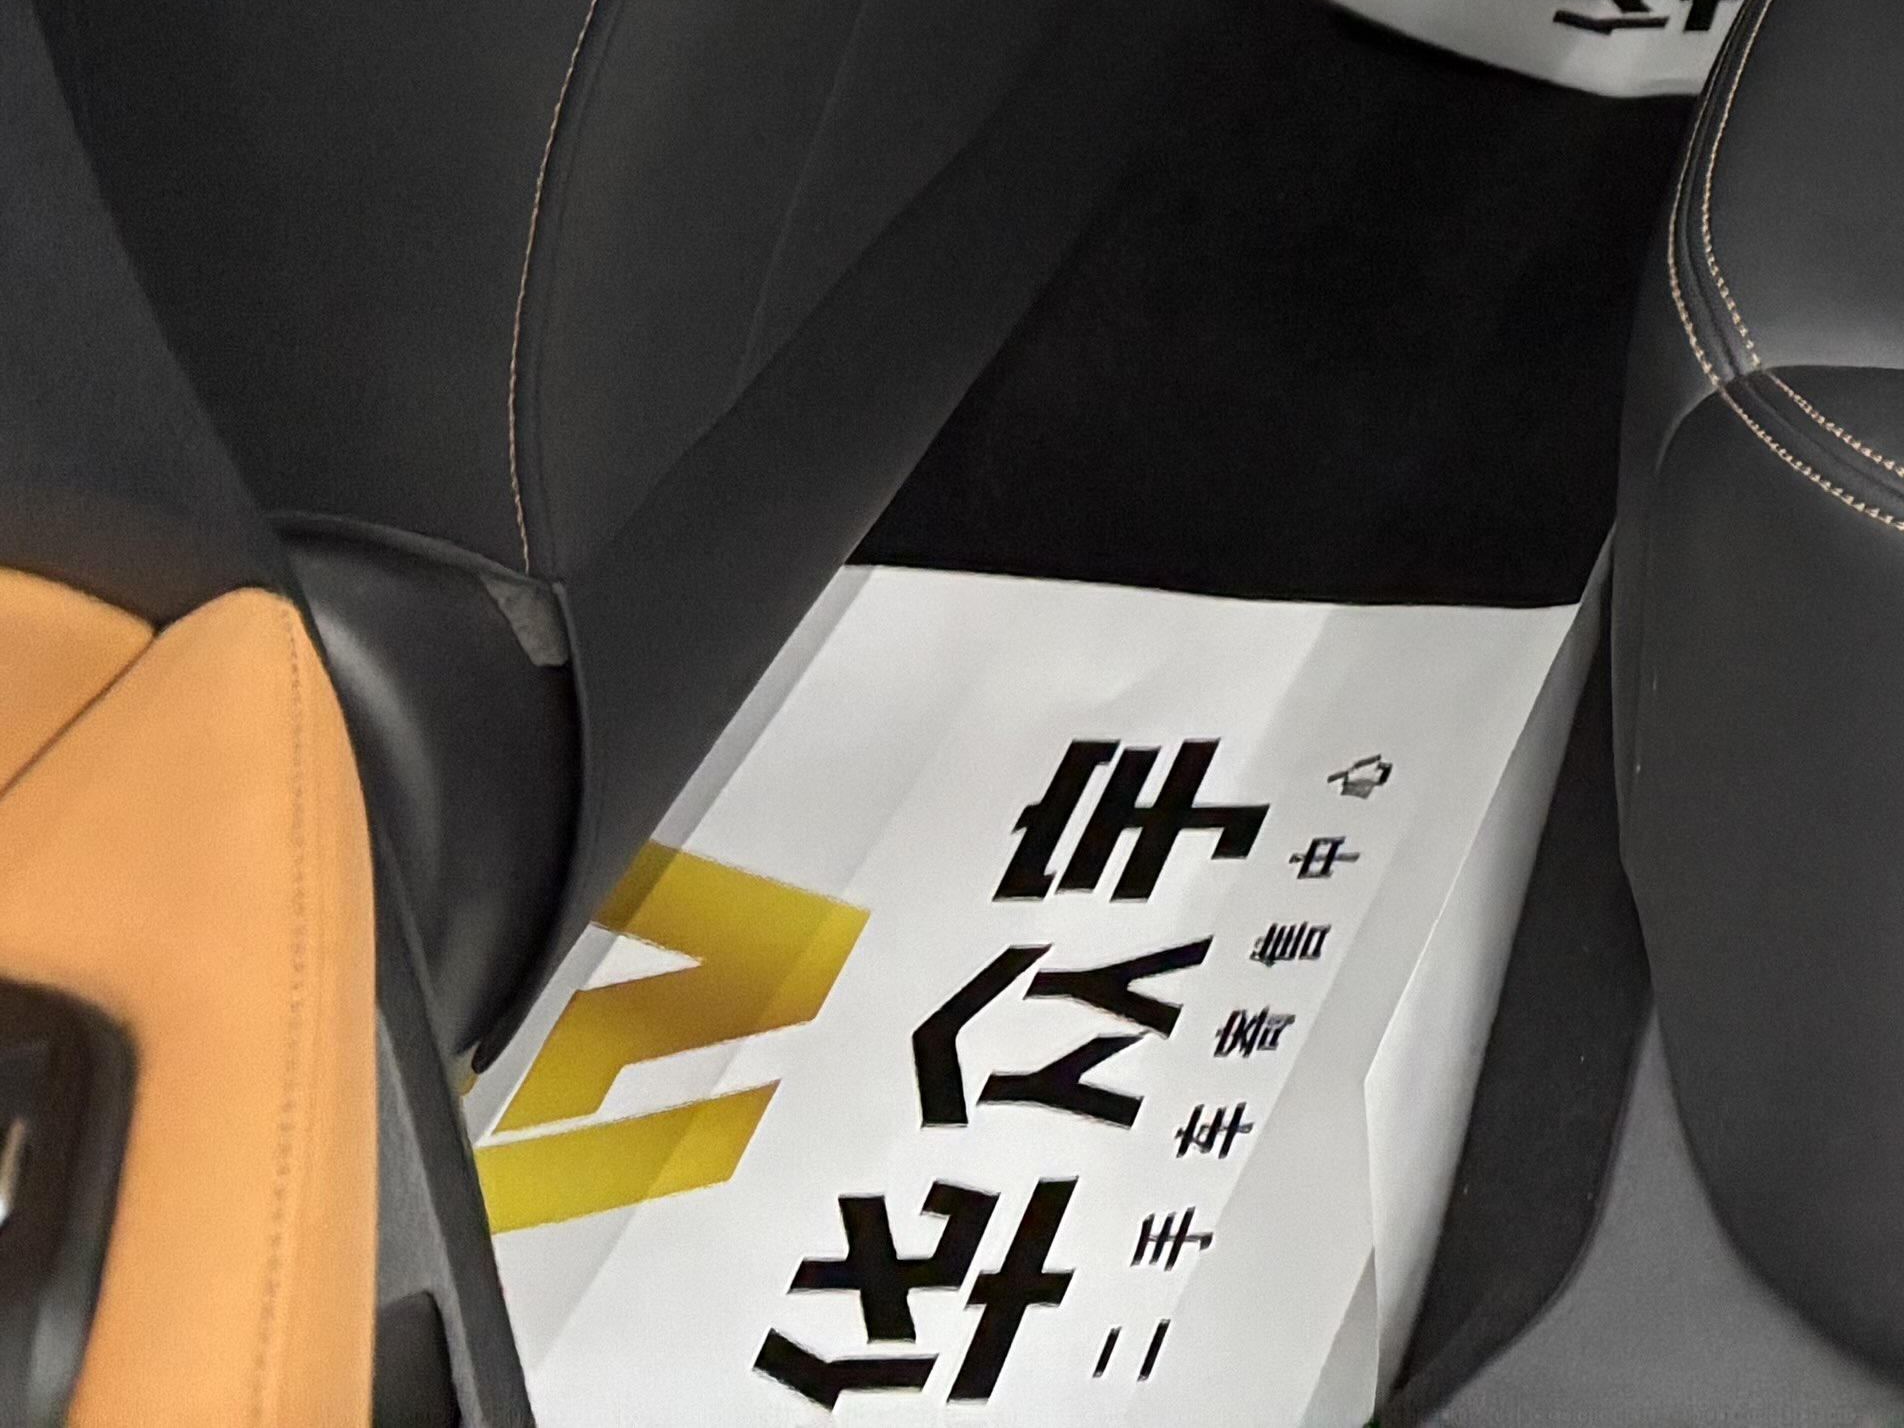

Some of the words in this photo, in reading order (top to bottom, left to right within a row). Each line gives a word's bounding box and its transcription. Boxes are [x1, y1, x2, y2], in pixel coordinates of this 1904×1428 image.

[752, 738, 1271, 1411] 华众宇
[1092, 753, 1393, 1382] 二手车寄售中心
